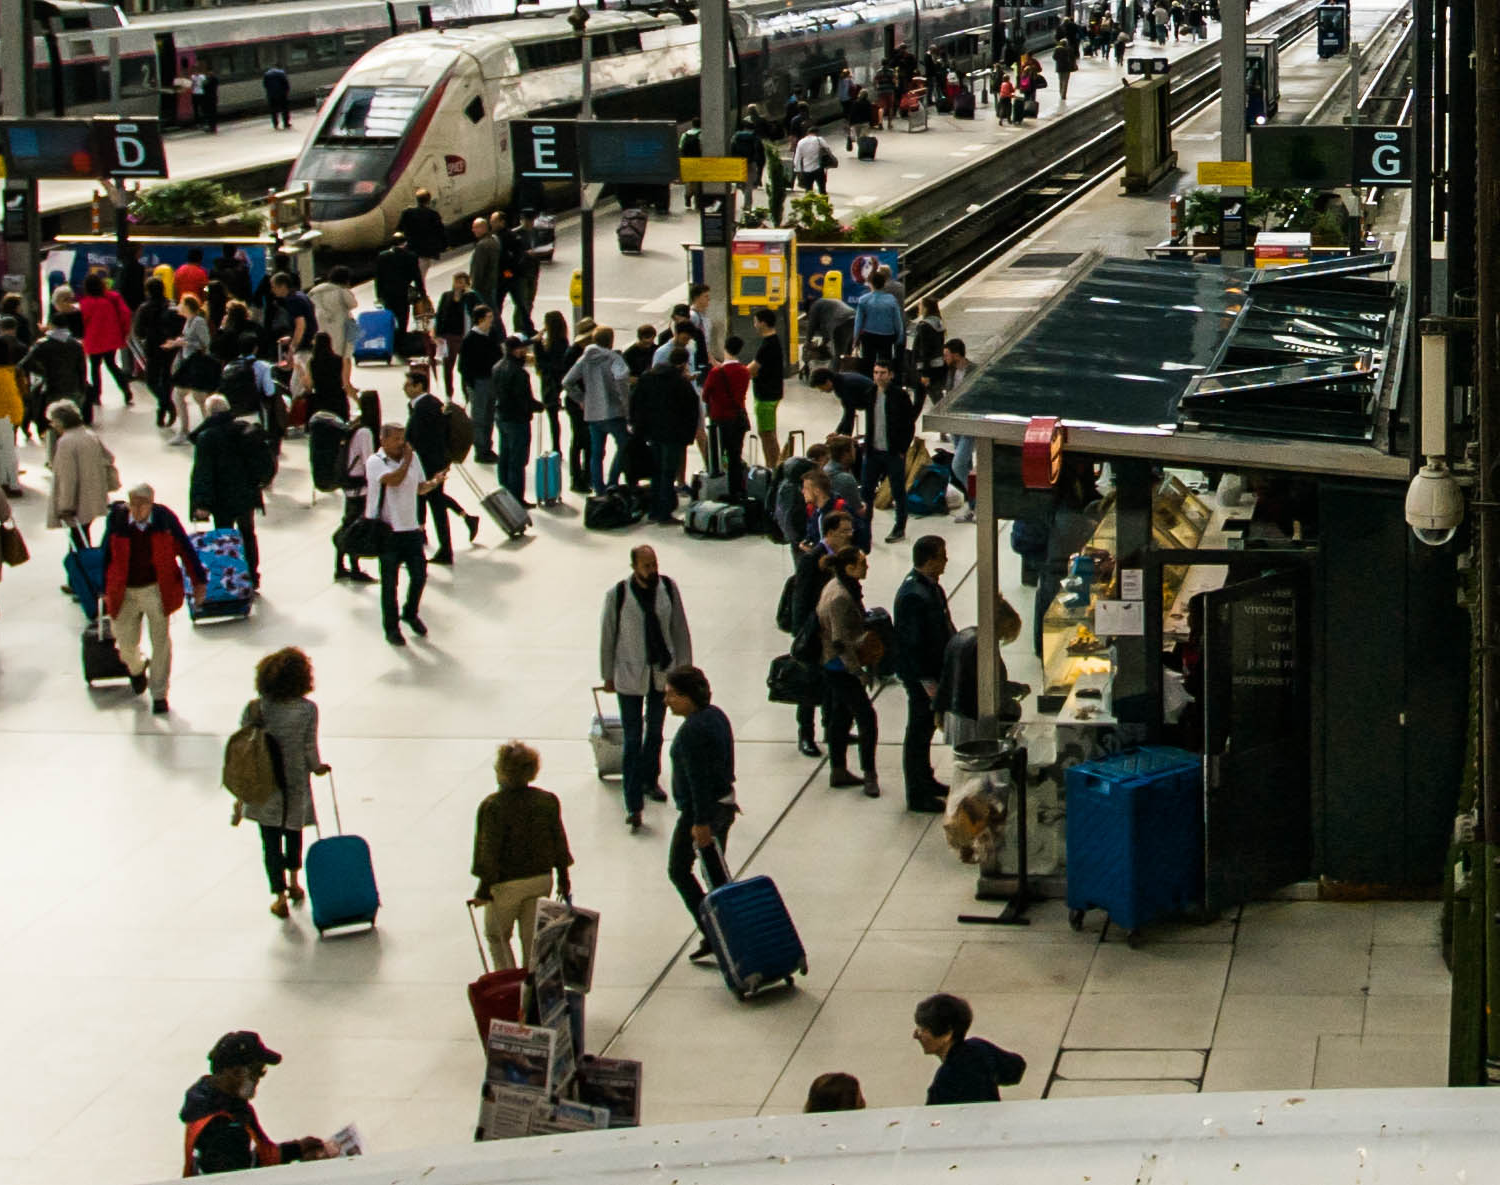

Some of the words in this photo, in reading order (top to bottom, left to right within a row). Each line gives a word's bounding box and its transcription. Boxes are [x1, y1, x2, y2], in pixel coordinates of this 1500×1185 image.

[114, 137, 145, 166] D
[533, 138, 558, 168] E
[1372, 145, 1400, 176] G
